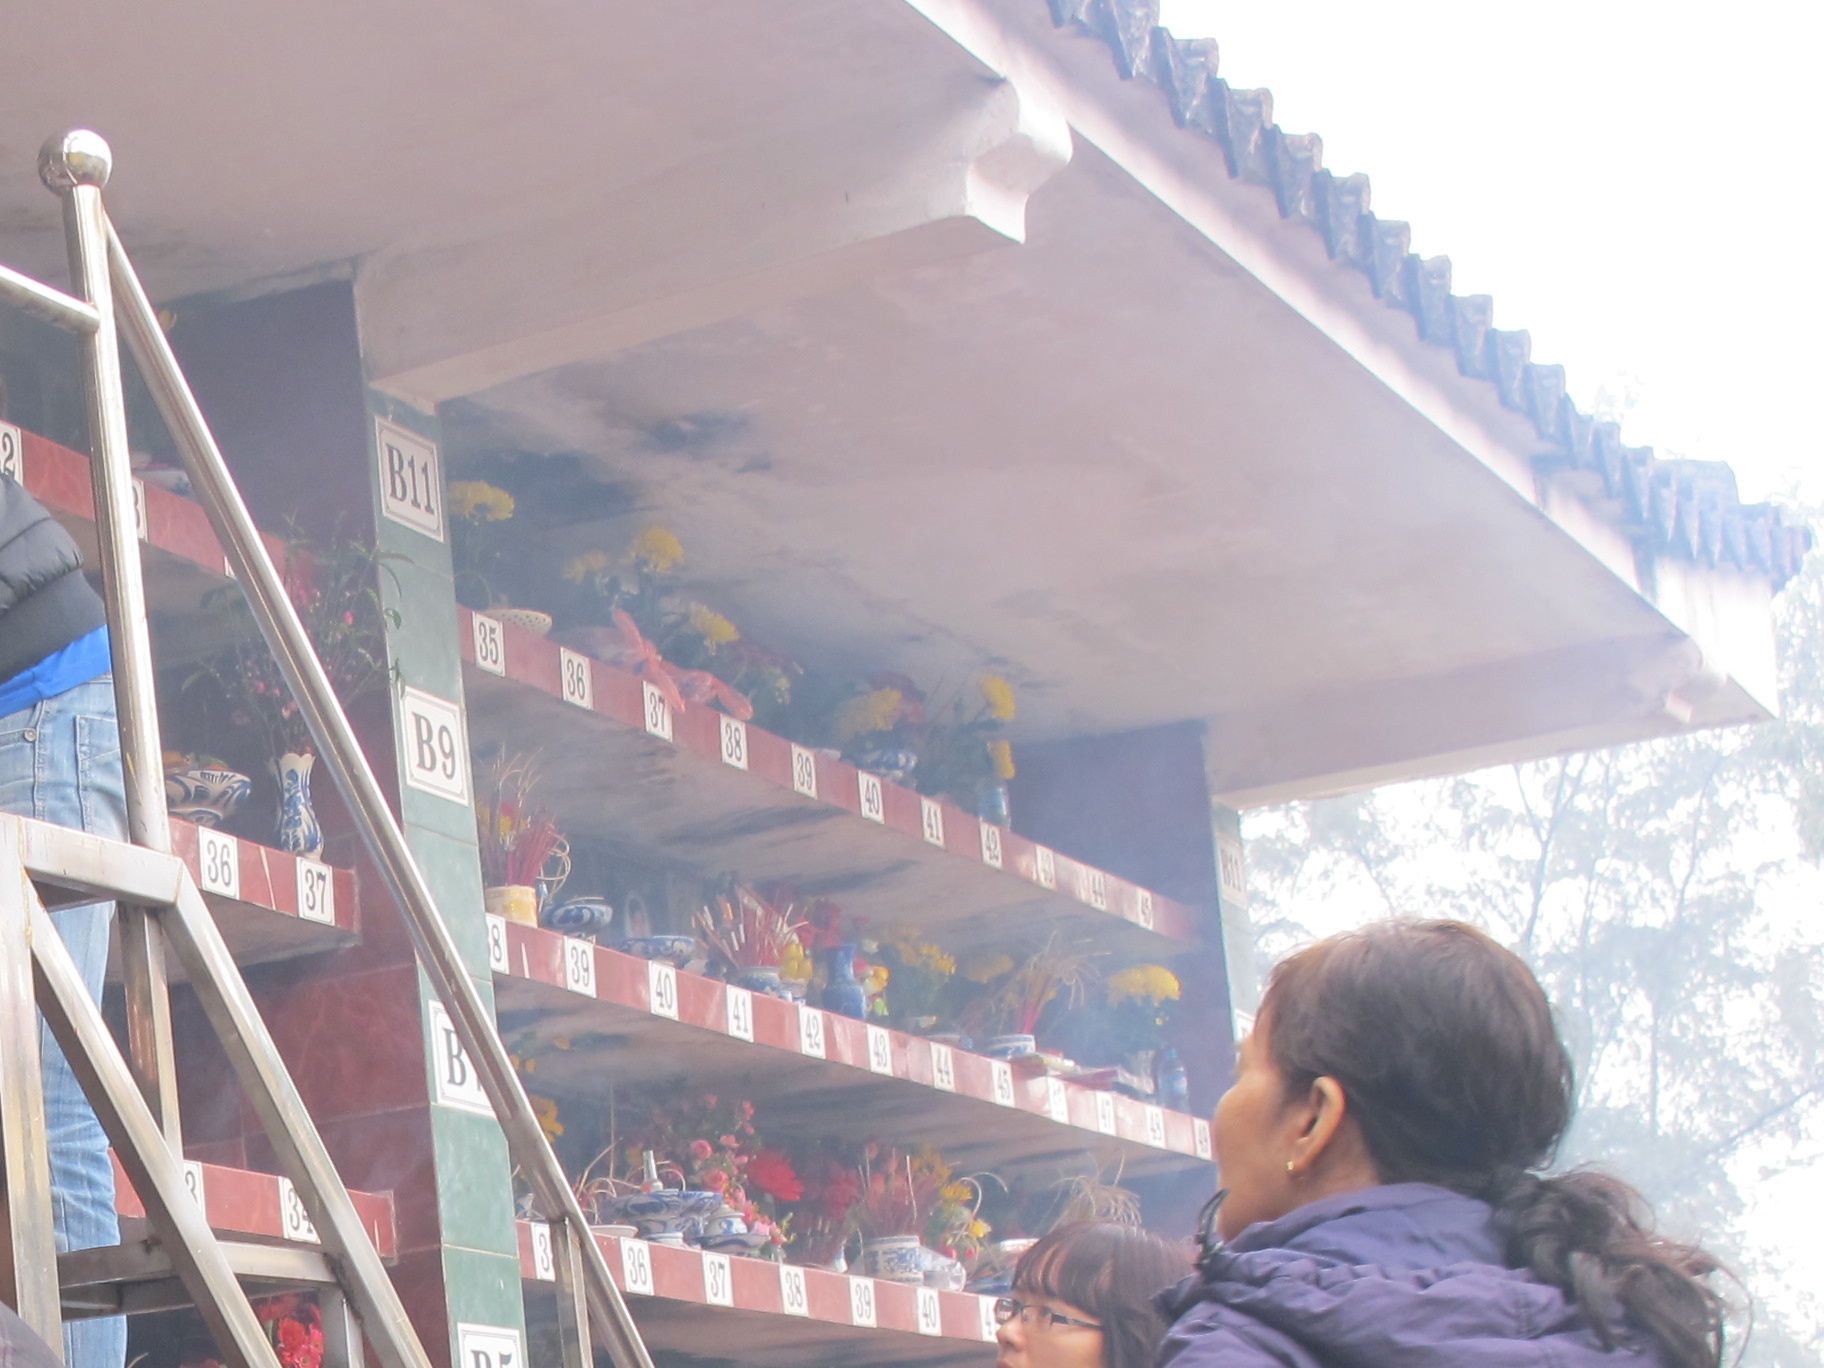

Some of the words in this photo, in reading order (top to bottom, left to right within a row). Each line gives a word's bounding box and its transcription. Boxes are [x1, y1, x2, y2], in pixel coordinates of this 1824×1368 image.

[388, 446, 433, 514] B11
[479, 620, 498, 664] 35
[567, 659, 585, 699] 36
[649, 692, 666, 732] 37
[413, 713, 455, 780] B9
[725, 723, 743, 762] 38
[797, 753, 813, 790] 39
[864, 779, 880, 815] 40
[926, 806, 941, 840] 41
[207, 839, 232, 887] 36
[306, 868, 326, 914] 37
[490, 925, 502, 963] 8
[571, 946, 590, 987] 39
[654, 973, 673, 1011] 40
[733, 998, 749, 1034] 41
[805, 1015, 821, 1050] 42
[936, 1052, 950, 1085] 44
[539, 1233, 551, 1272] 3
[628, 1247, 647, 1286] 36
[709, 1261, 725, 1298] 37
[785, 1272, 803, 1308] 38
[855, 1282, 871, 1319] 39
[922, 1294, 937, 1327] 40
